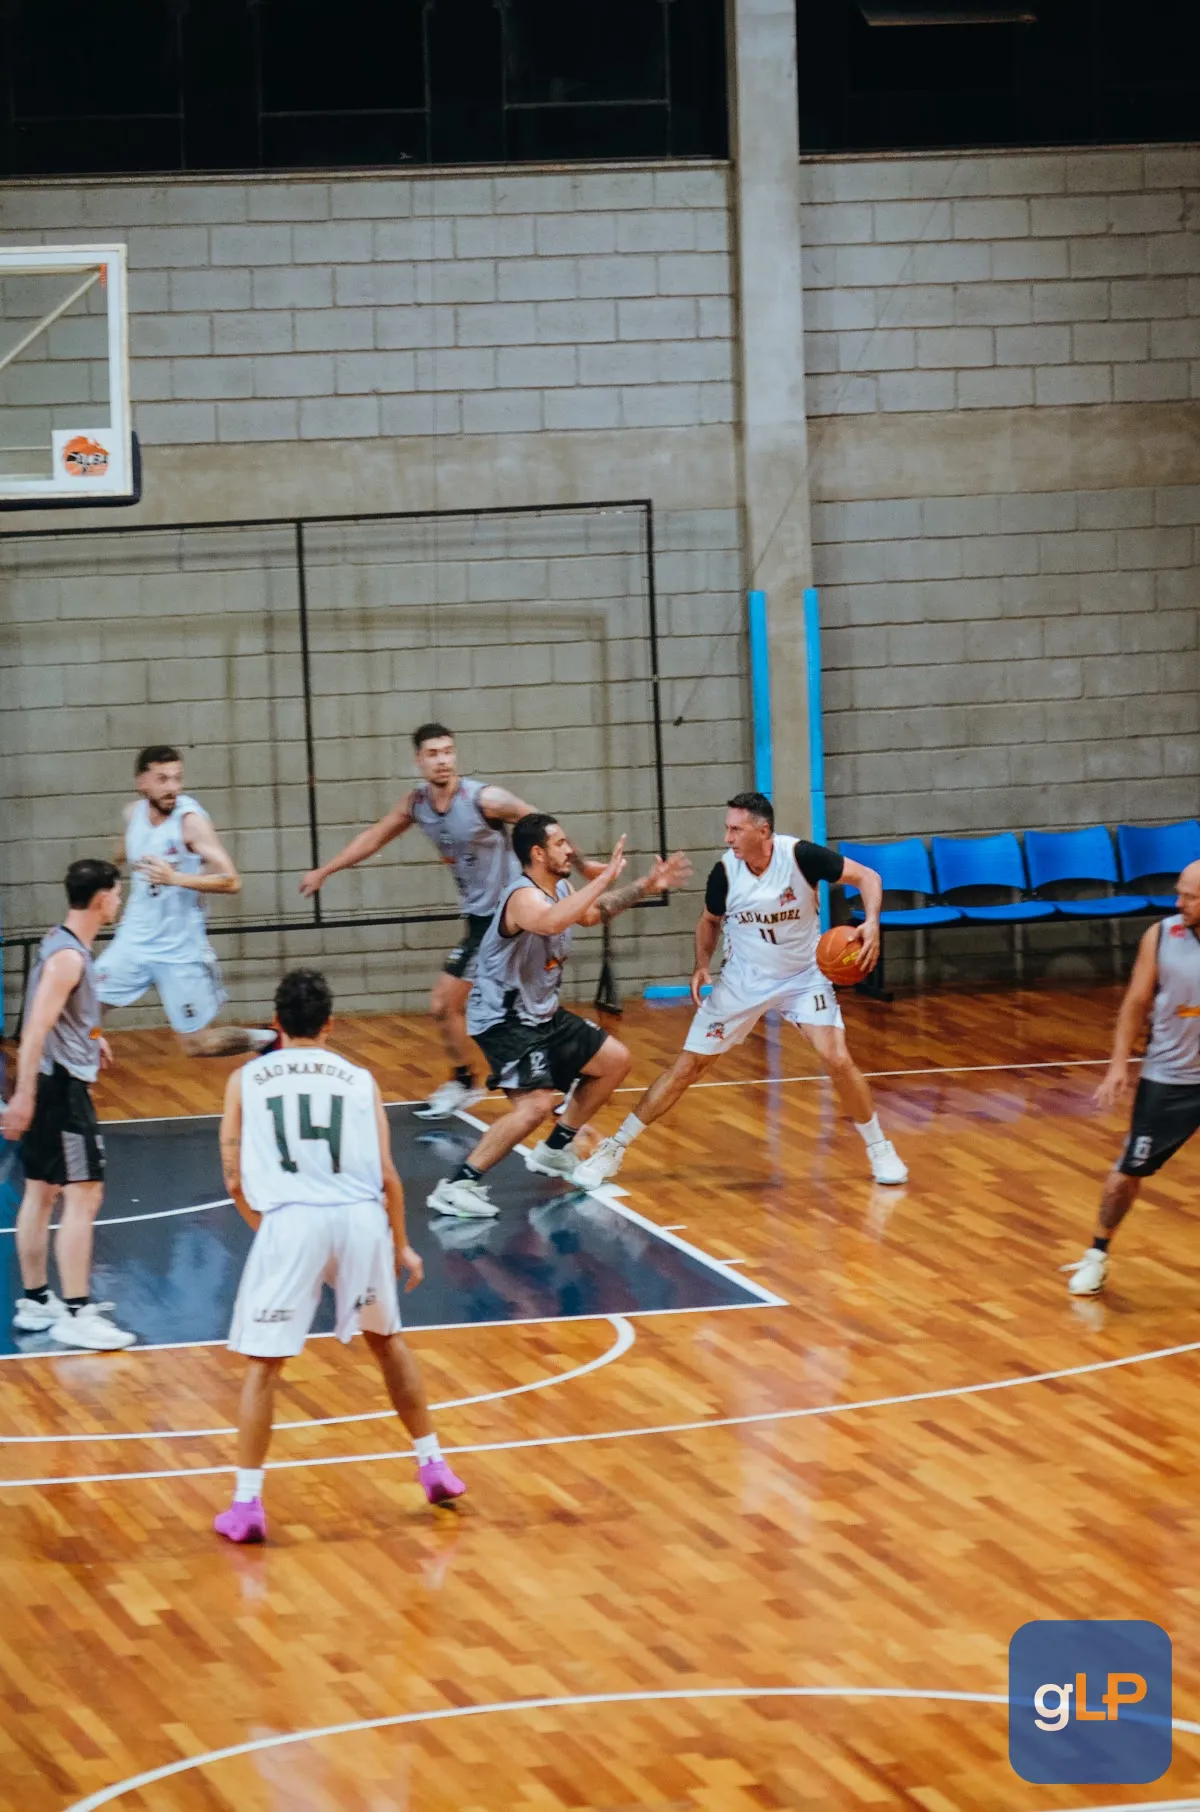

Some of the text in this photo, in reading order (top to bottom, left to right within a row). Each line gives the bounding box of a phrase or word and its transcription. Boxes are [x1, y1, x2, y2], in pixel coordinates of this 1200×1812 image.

[754, 908, 801, 924] MANUEL
[759, 927, 777, 945] 11
[814, 994, 827, 1011] 11
[287, 1063, 354, 1086] MANUEL
[265, 1093, 344, 1174] 14
